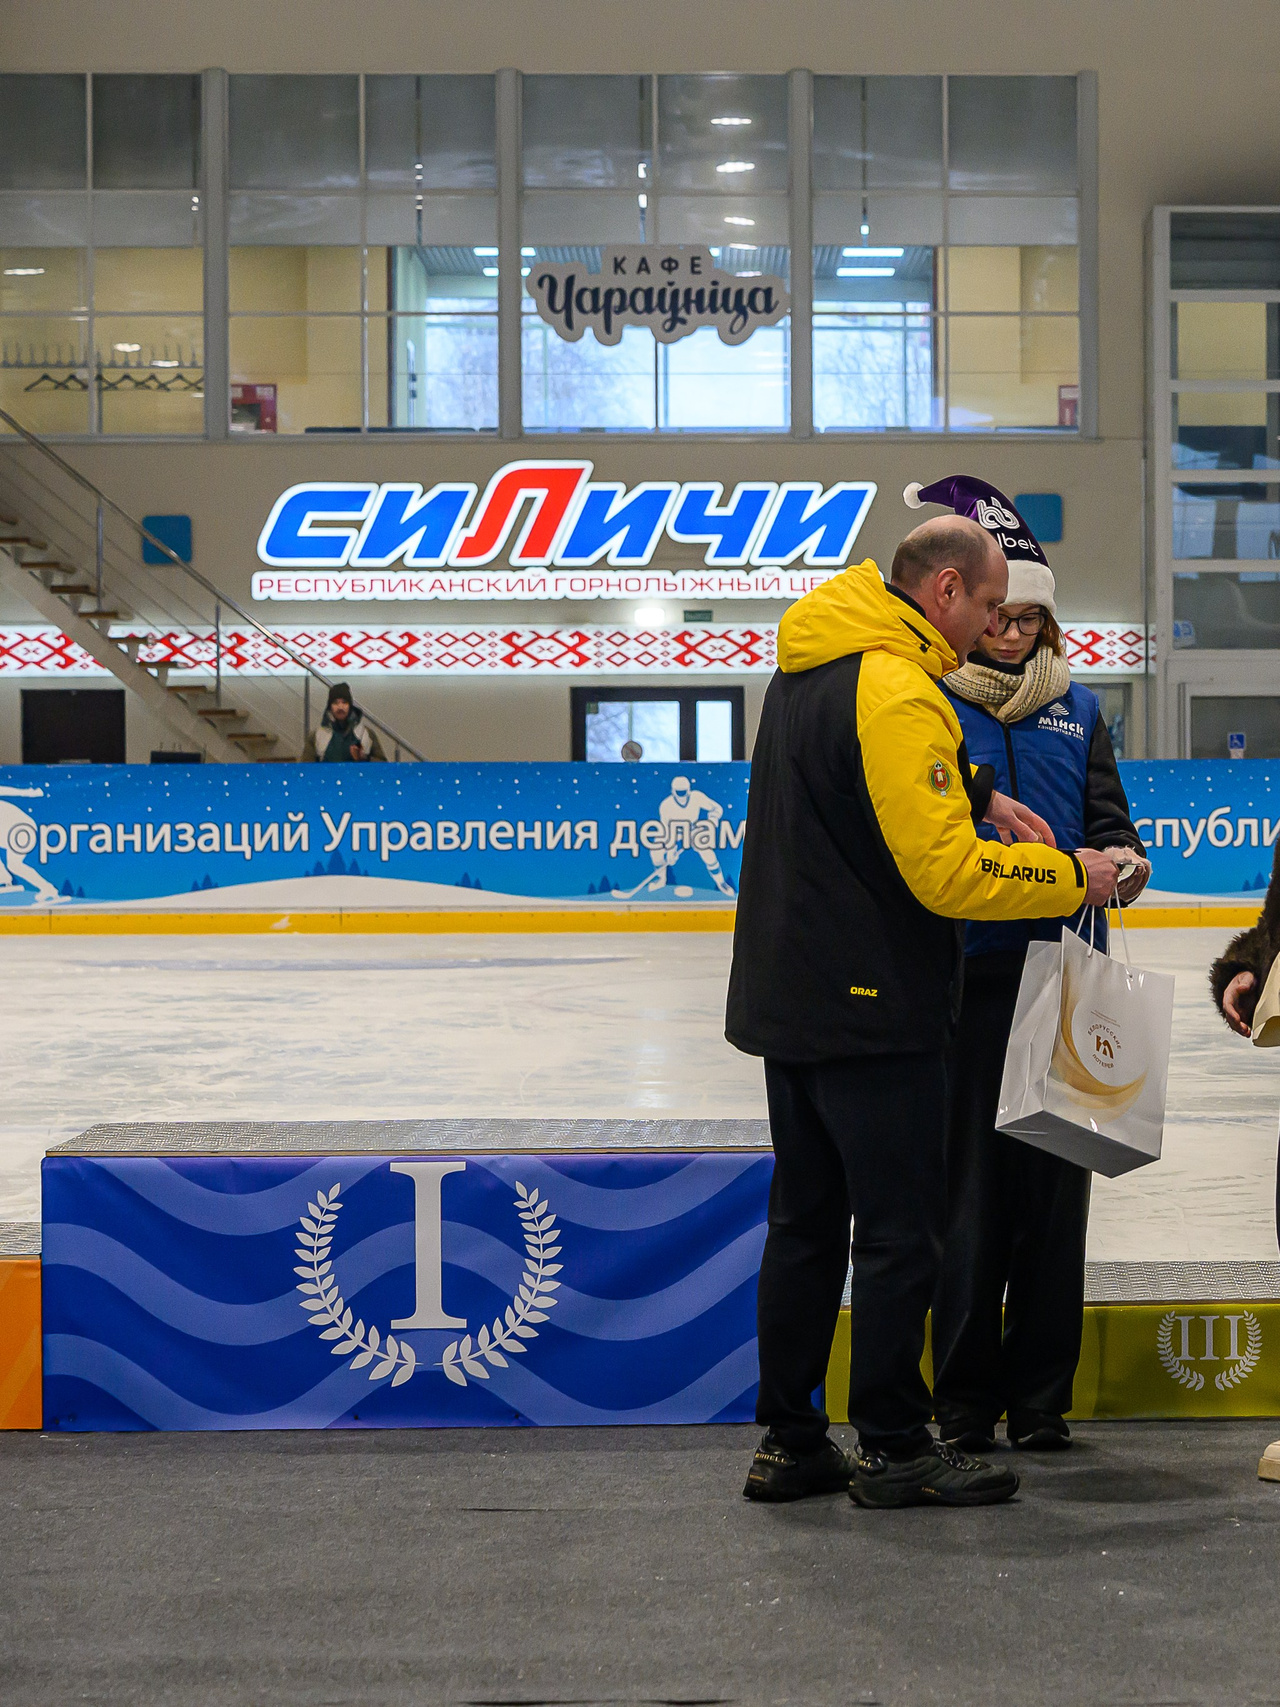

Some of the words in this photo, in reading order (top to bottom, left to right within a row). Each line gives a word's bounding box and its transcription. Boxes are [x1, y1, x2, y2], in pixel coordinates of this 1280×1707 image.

[613, 256, 703, 275] КАФЕ
[538, 273, 780, 335] Чараўніца
[996, 532, 1039, 557] lbet
[258, 573, 551, 594] РЕСПУБЛИКАНСКИЙ
[555, 572, 781, 593] ГОРНОЛЫЖНЫЙ
[789, 576, 831, 594] ЦЕ
[7, 810, 311, 864] организаций
[320, 811, 599, 861] Управления
[609, 818, 746, 858] делам
[980, 858, 1057, 885] BELARUS
[850, 986, 878, 997] ORAZ
[1174, 1315, 1245, 1361] III
